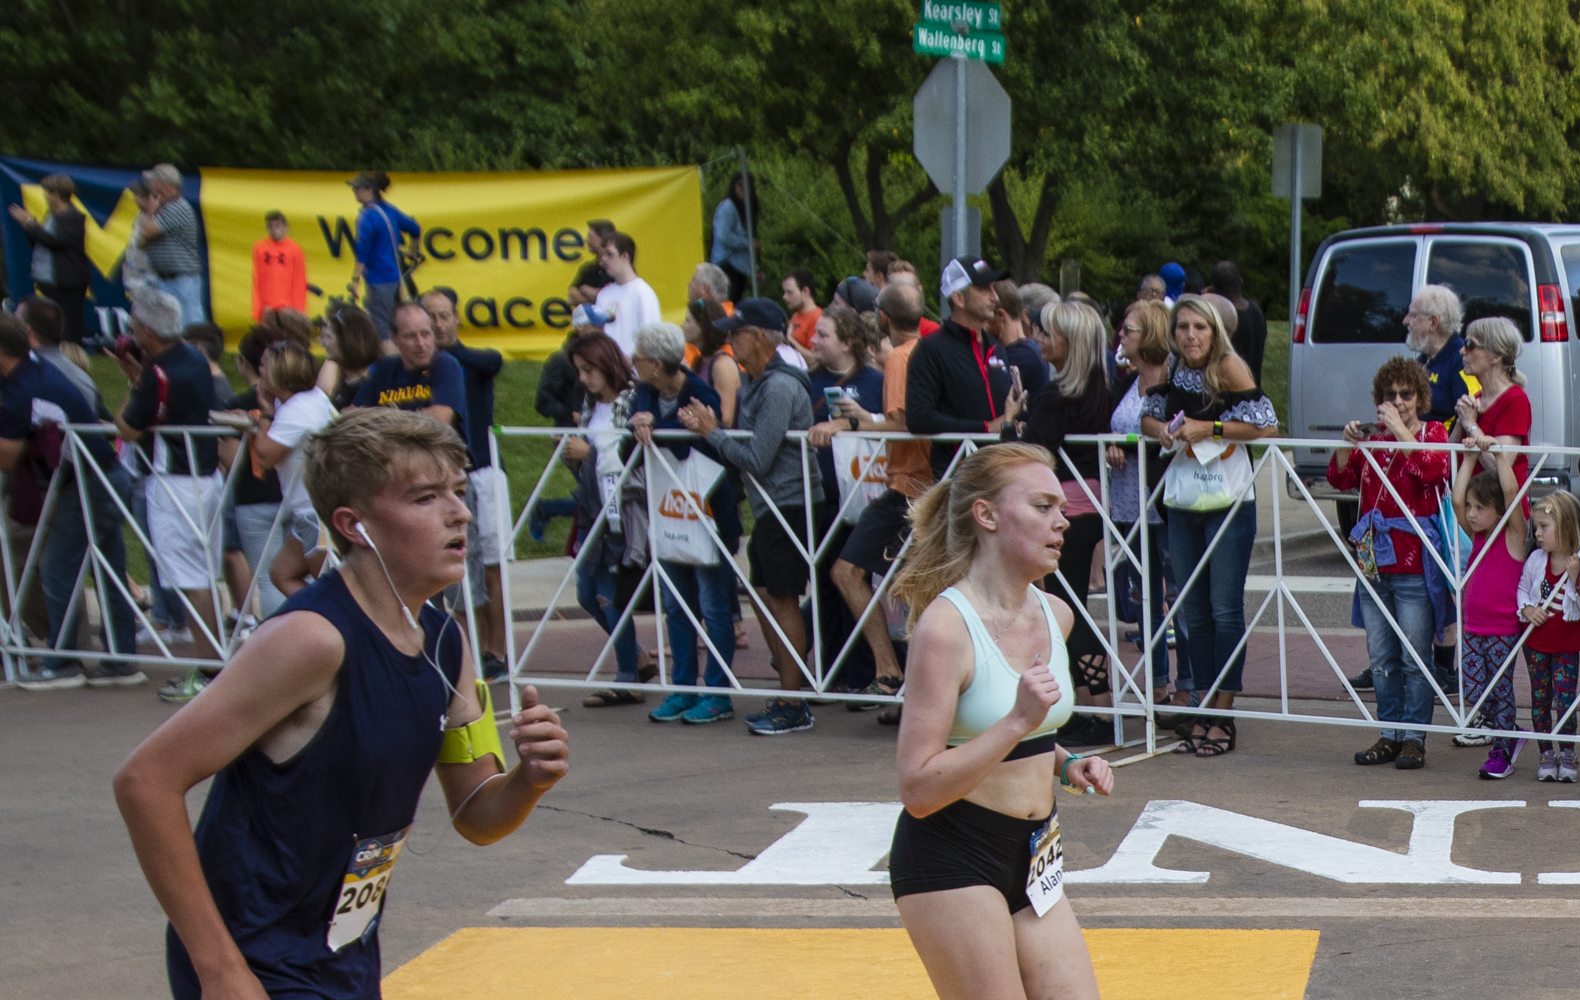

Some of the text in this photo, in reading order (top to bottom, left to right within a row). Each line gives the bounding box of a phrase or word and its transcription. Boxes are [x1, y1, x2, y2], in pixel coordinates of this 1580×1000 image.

[924, 0, 982, 30] Kearsley
[918, 27, 985, 59] Wallenberg
[316, 214, 585, 262] Wcome
[464, 296, 573, 328] ace
[1028, 837, 1063, 887] 2042
